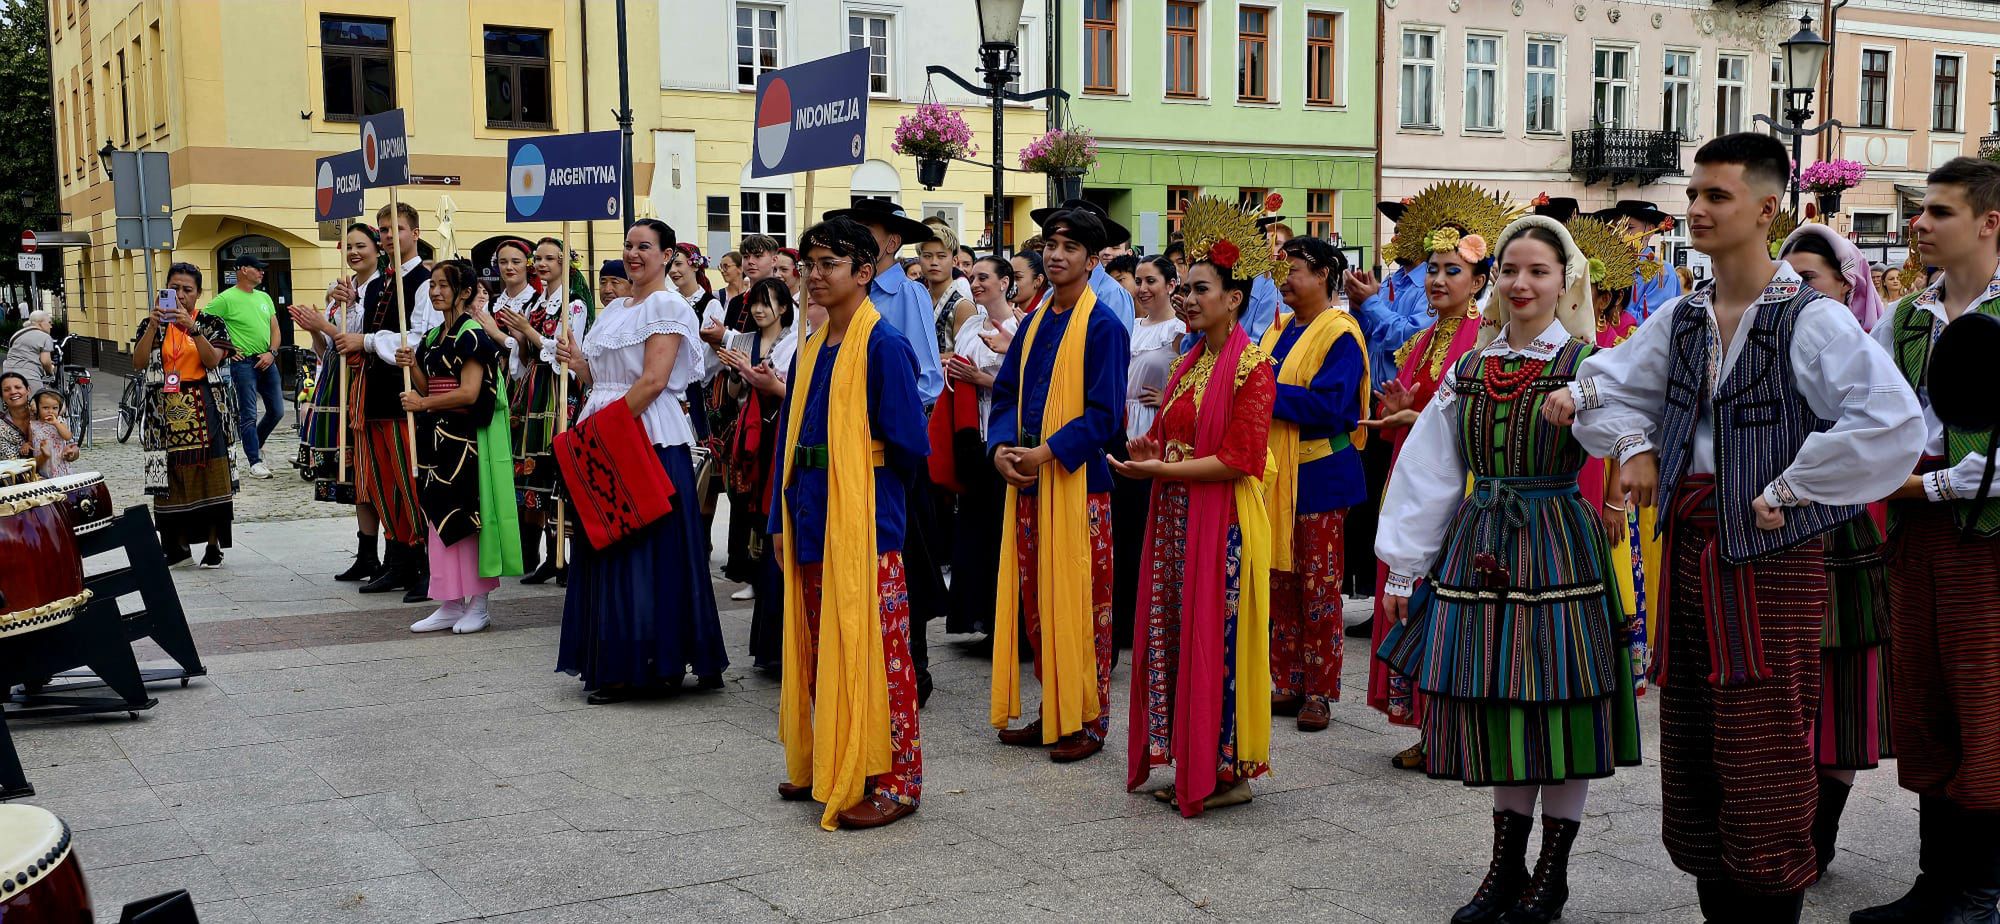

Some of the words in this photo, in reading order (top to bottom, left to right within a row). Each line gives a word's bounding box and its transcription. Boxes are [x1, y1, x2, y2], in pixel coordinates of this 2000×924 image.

[795, 97, 860, 131] INDONEZJA
[379, 136, 406, 160] JAPONIA
[336, 173, 361, 194] POLSKA
[548, 165, 616, 186] ARGENTYNA
